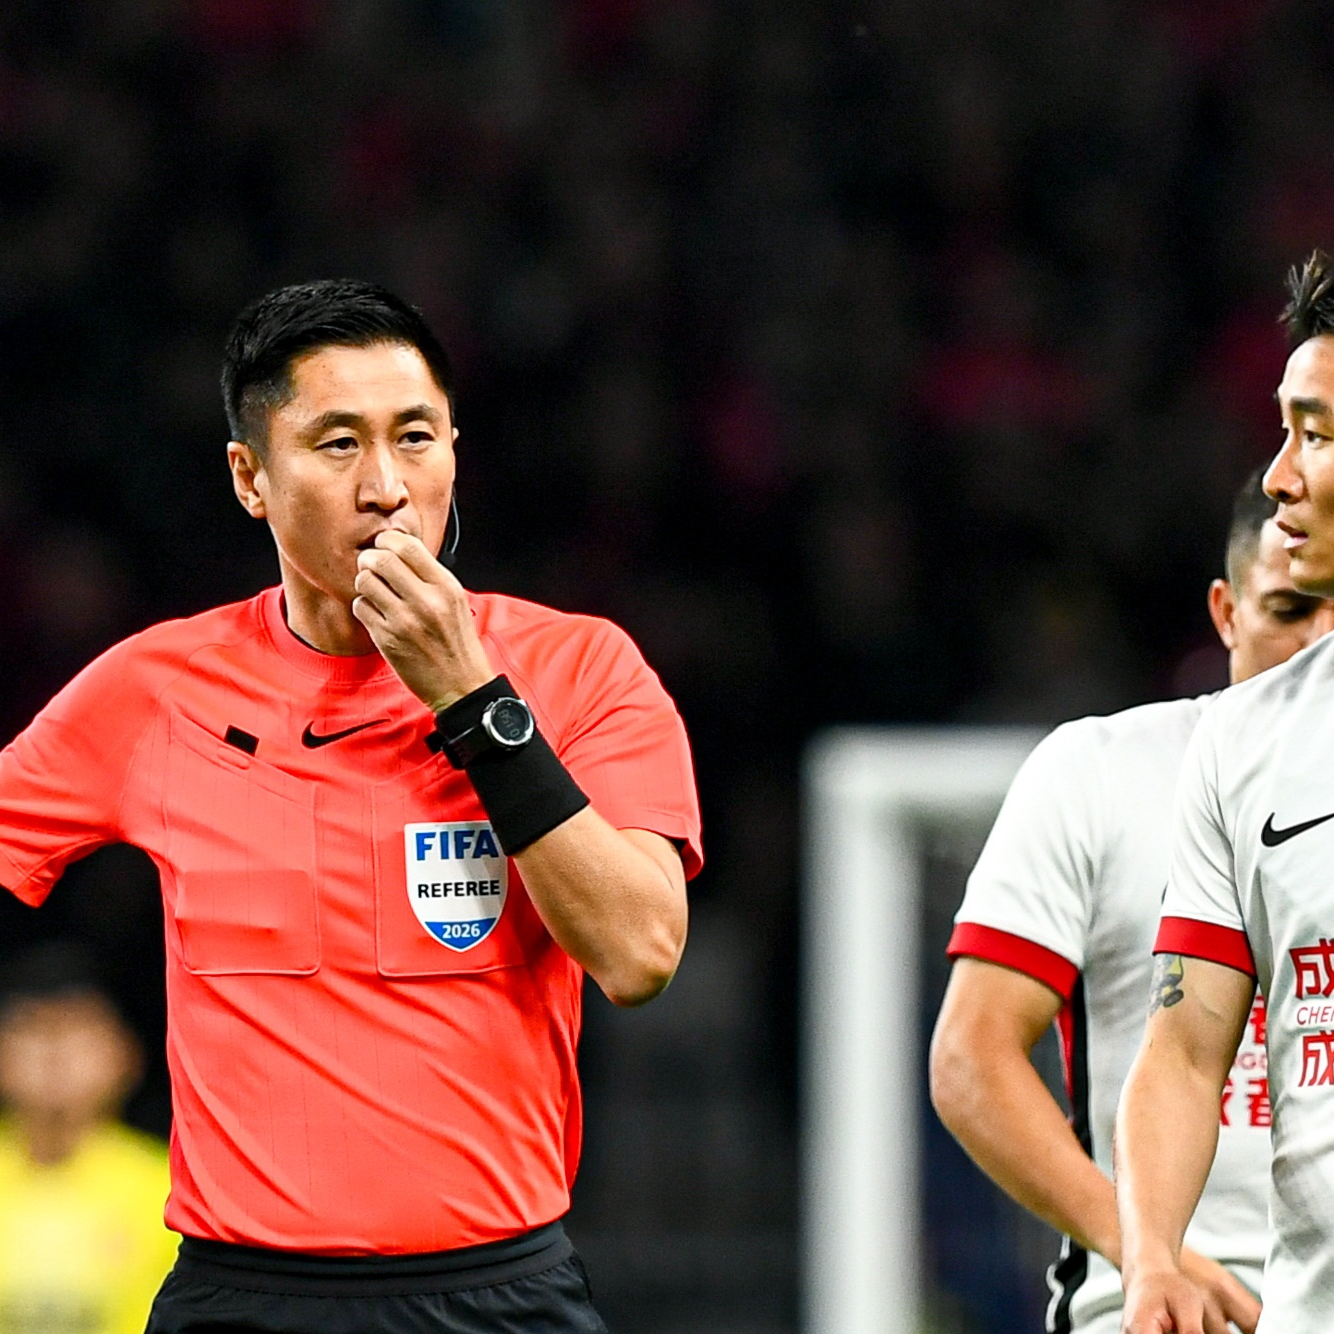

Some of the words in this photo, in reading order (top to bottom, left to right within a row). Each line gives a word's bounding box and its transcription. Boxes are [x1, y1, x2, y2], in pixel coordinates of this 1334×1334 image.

[415, 829, 500, 861] FIFA
[417, 880, 501, 898] REFEREE
[442, 923, 481, 939] 2026
